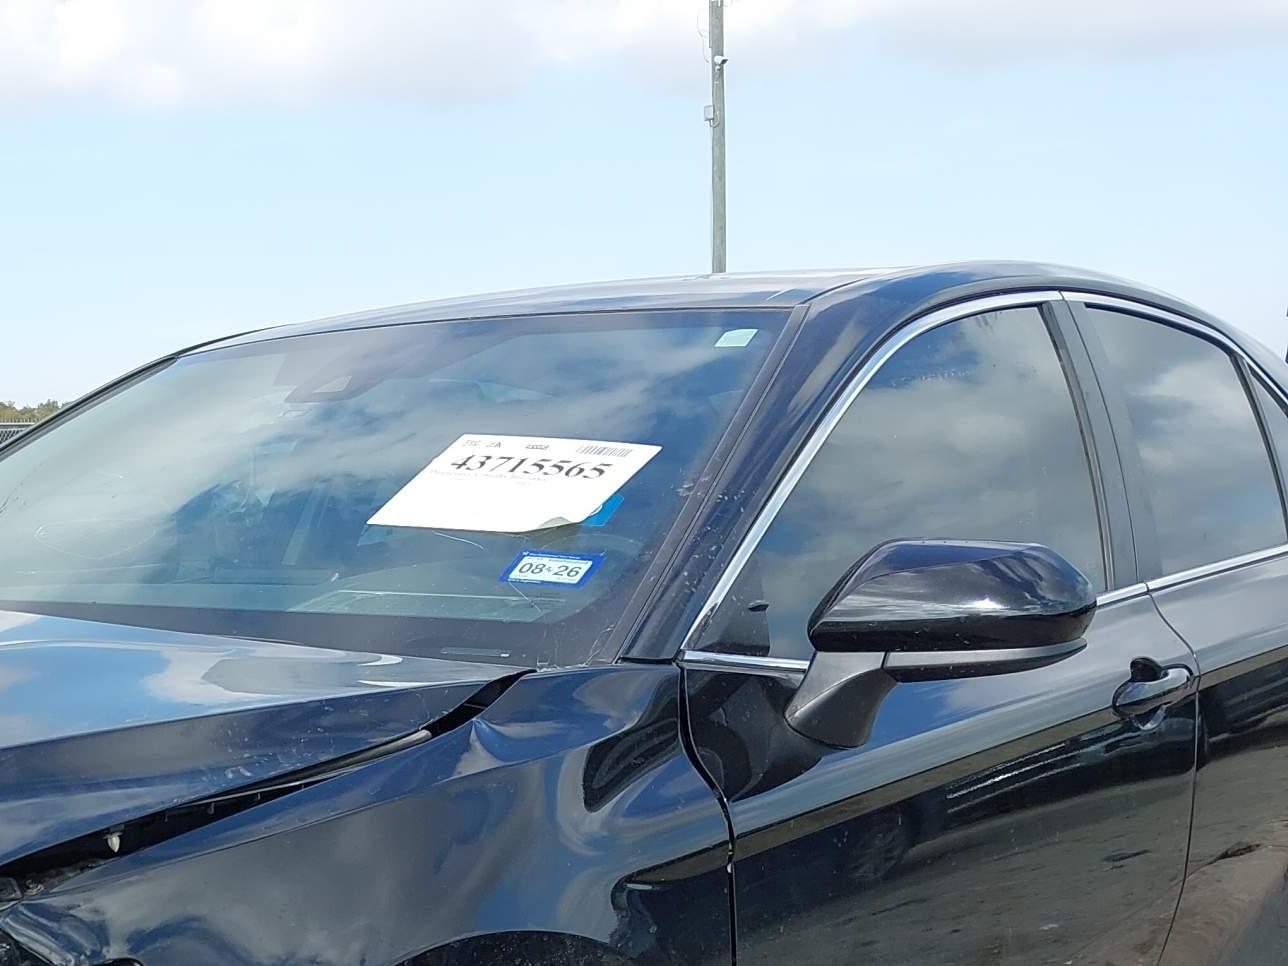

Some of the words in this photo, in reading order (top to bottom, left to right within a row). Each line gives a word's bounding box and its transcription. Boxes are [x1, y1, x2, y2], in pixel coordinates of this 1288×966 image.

[450, 454, 614, 479] 43715565
[518, 562, 546, 574] 08
[552, 565, 582, 577] 26
